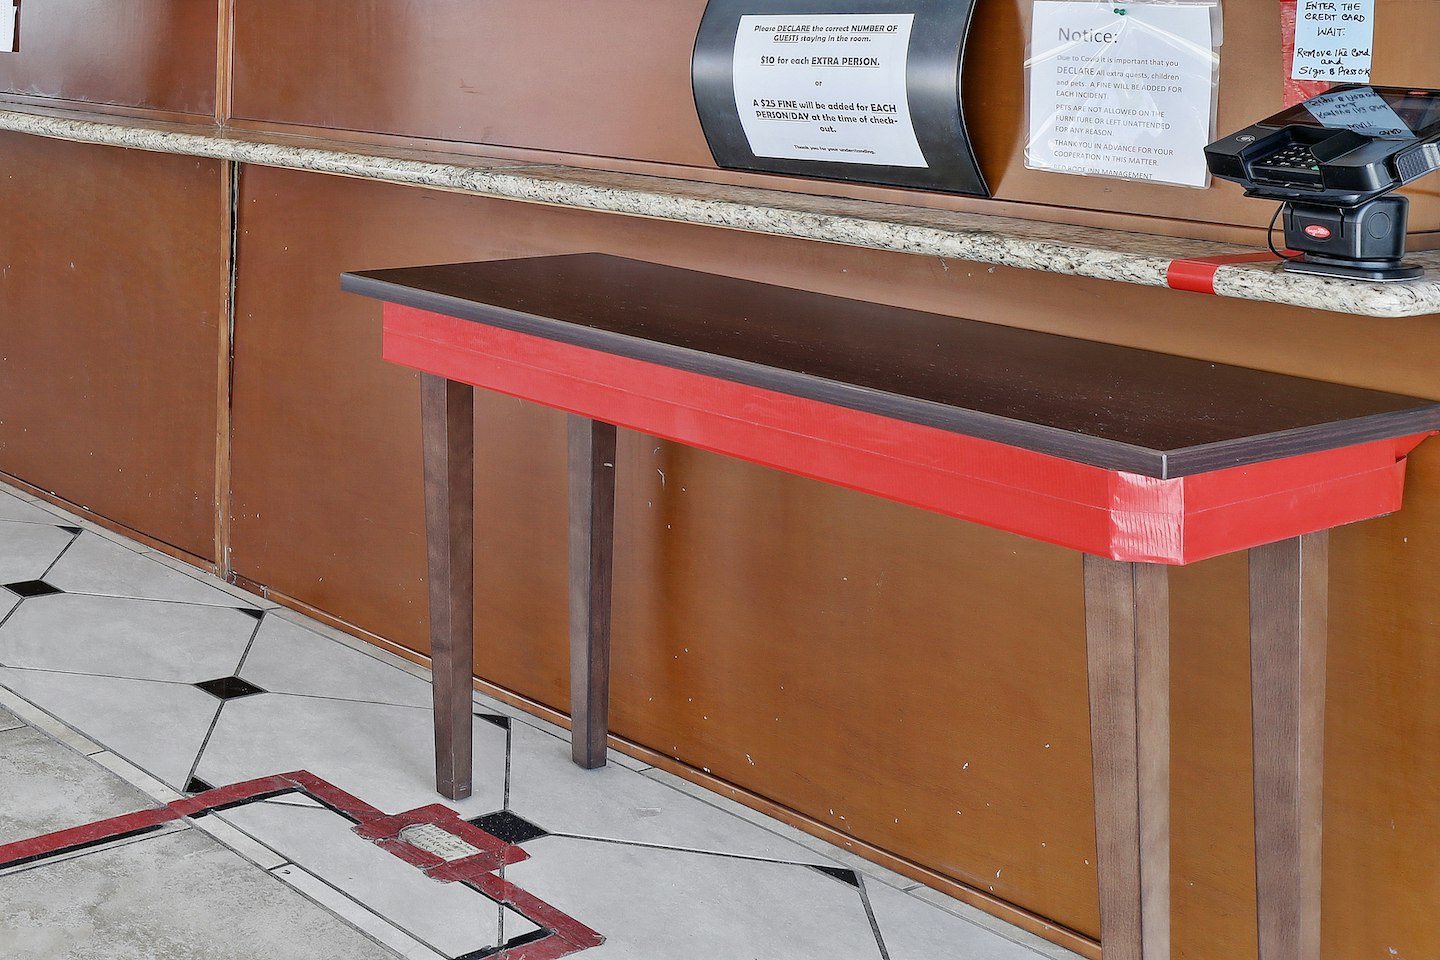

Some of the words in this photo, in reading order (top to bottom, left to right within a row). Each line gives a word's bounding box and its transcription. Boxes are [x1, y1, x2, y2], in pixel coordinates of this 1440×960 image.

[1305, 1, 1336, 11] ENTER
[1341, 3, 1361, 11] THE
[1305, 13, 1337, 21] CREDIT
[1341, 14, 1365, 22] CARD
[777, 25, 810, 33] DECLARE
[800, 35, 826, 43] staying
[1058, 27, 1118, 44] Notice:
[1297, 48, 1332, 59] Remove
[761, 56, 775, 65] $10
[777, 56, 788, 64] for
[790, 57, 809, 65] each
[811, 57, 839, 65] EXTRA
[842, 58, 880, 66] PERSON.
[1321, 57, 1344, 65] and
[1057, 66, 1095, 75] DECLARE
[1299, 66, 1325, 78] Sign
[753, 99, 759, 107] A
[761, 99, 775, 108] $25
[778, 100, 797, 109] FINE
[799, 101, 814, 109] will
[816, 102, 826, 110] be
[828, 103, 854, 111] added
[856, 103, 868, 112] for
[871, 104, 897, 113] EACH
[756, 110, 809, 121] PERSON/DAY
[823, 114, 836, 122] the
[838, 115, 857, 123] time
[870, 116, 898, 124] check-
[1054, 151, 1101, 160] COOPERATION
[1128, 157, 1159, 166] MATTER.
